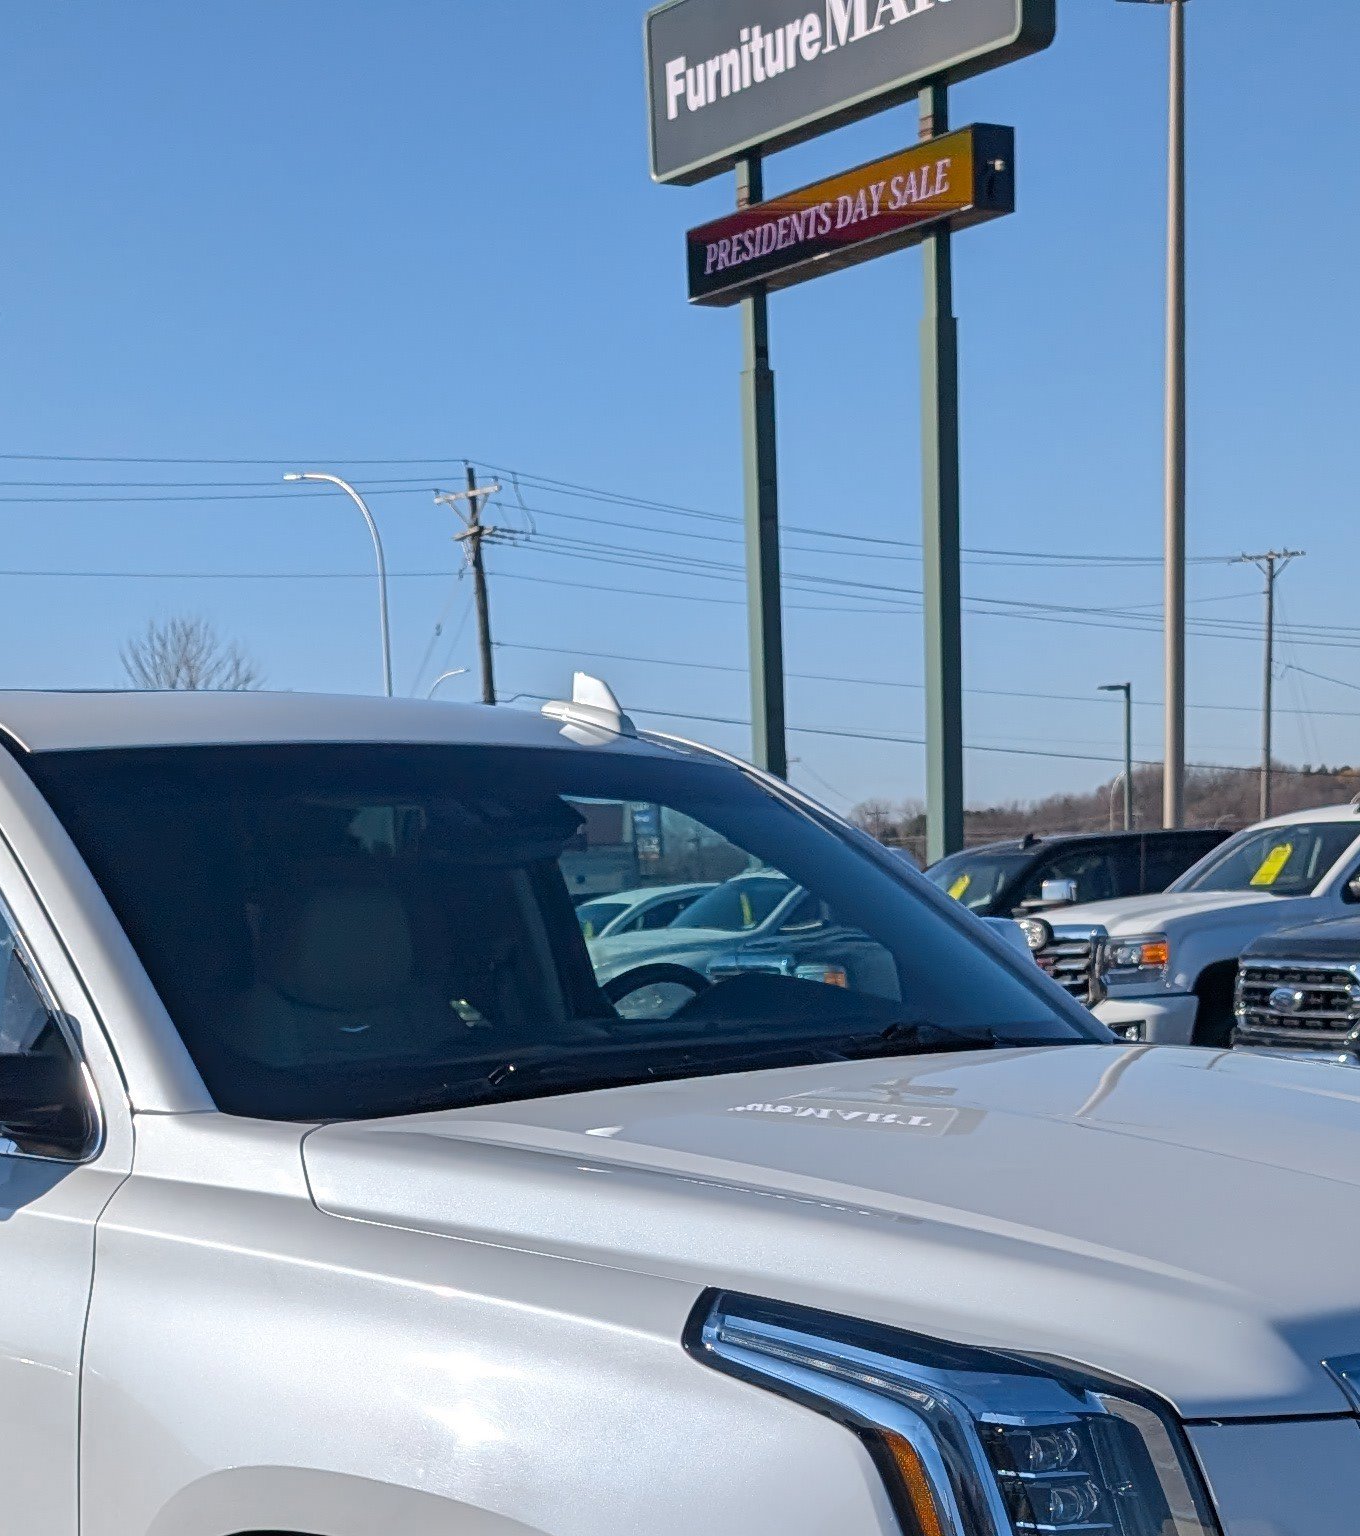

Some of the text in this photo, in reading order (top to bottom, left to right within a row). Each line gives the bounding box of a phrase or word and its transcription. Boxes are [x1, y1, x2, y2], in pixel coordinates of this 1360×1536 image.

[703, 157, 953, 275] PRESIDENTS DAY SALE
